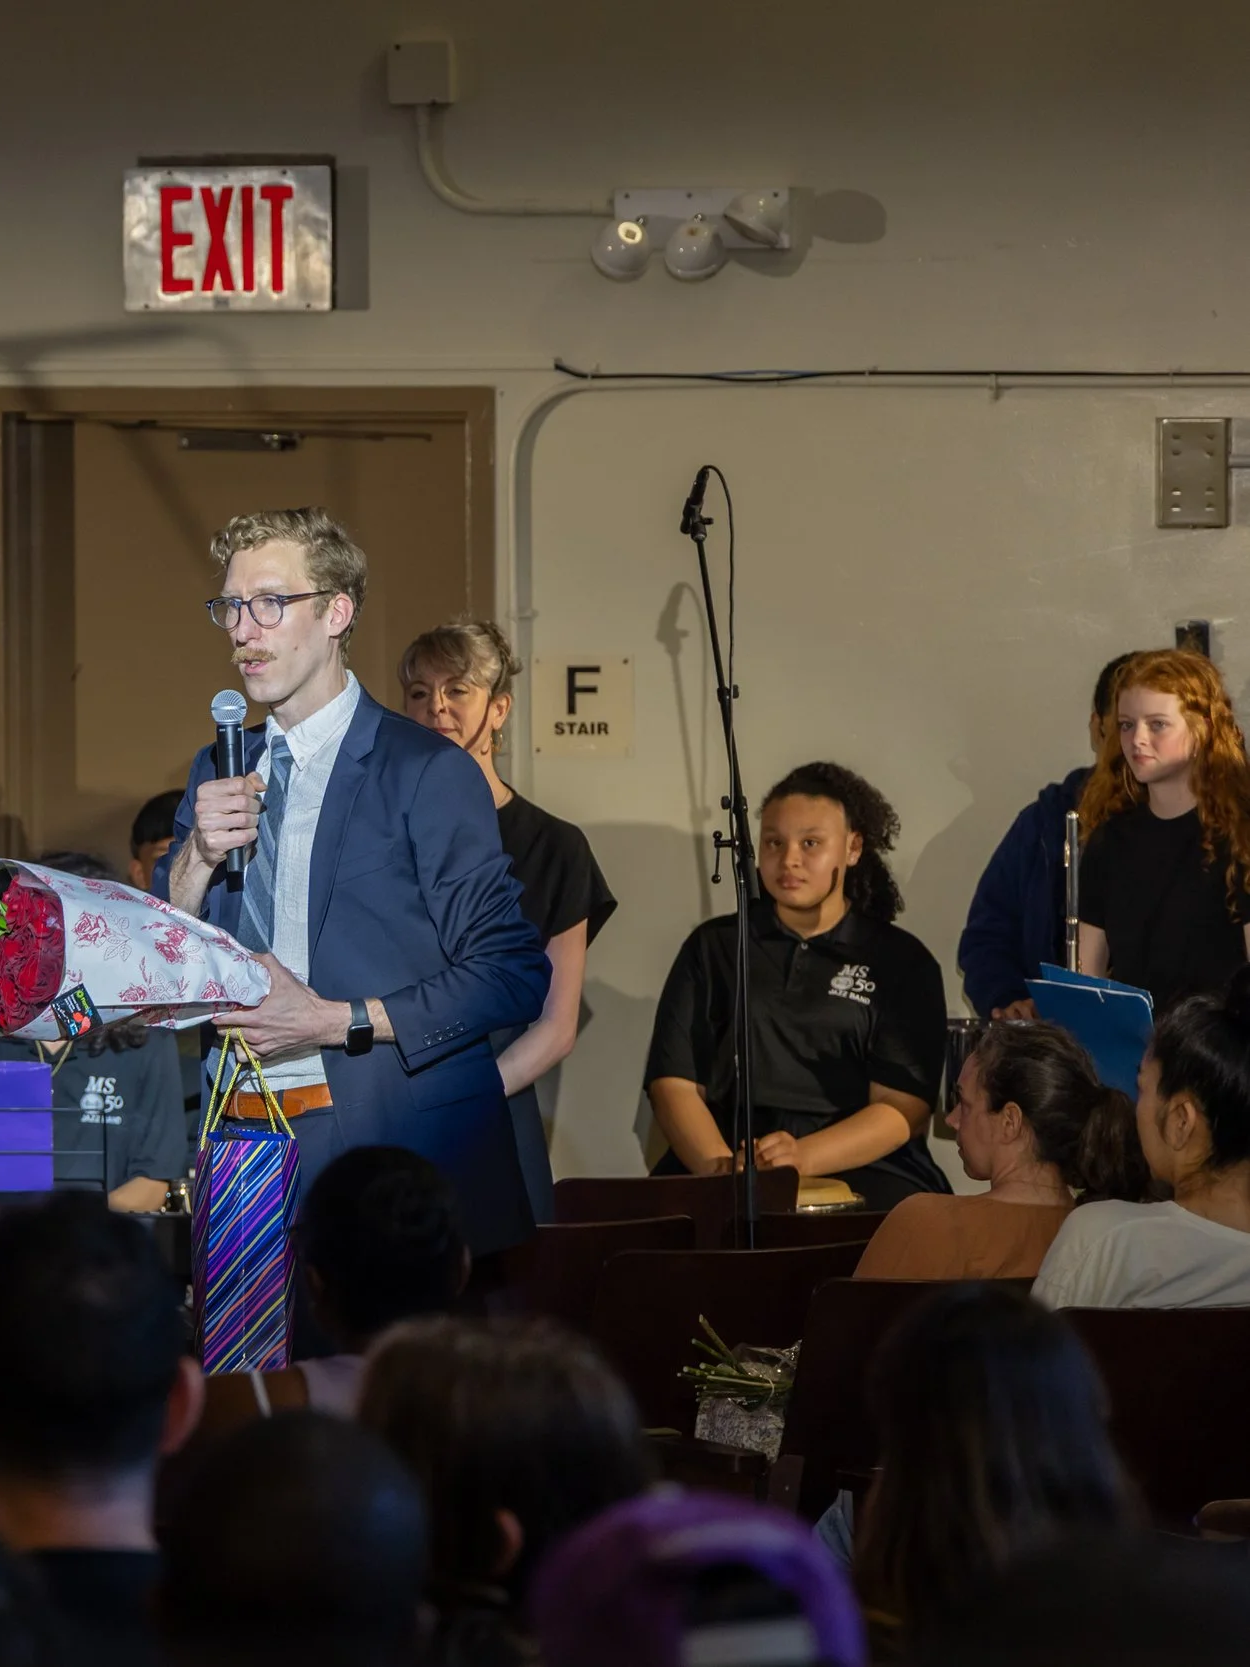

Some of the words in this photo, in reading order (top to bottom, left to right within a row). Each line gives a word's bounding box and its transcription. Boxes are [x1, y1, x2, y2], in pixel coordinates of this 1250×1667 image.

[160, 185, 294, 293] EXIT
[567, 665, 601, 715] F
[554, 721, 609, 736] STAIR
[837, 964, 870, 978] MS
[851, 978, 876, 992] 50
[84, 1075, 117, 1094] MS
[104, 1095, 124, 1113] 50
